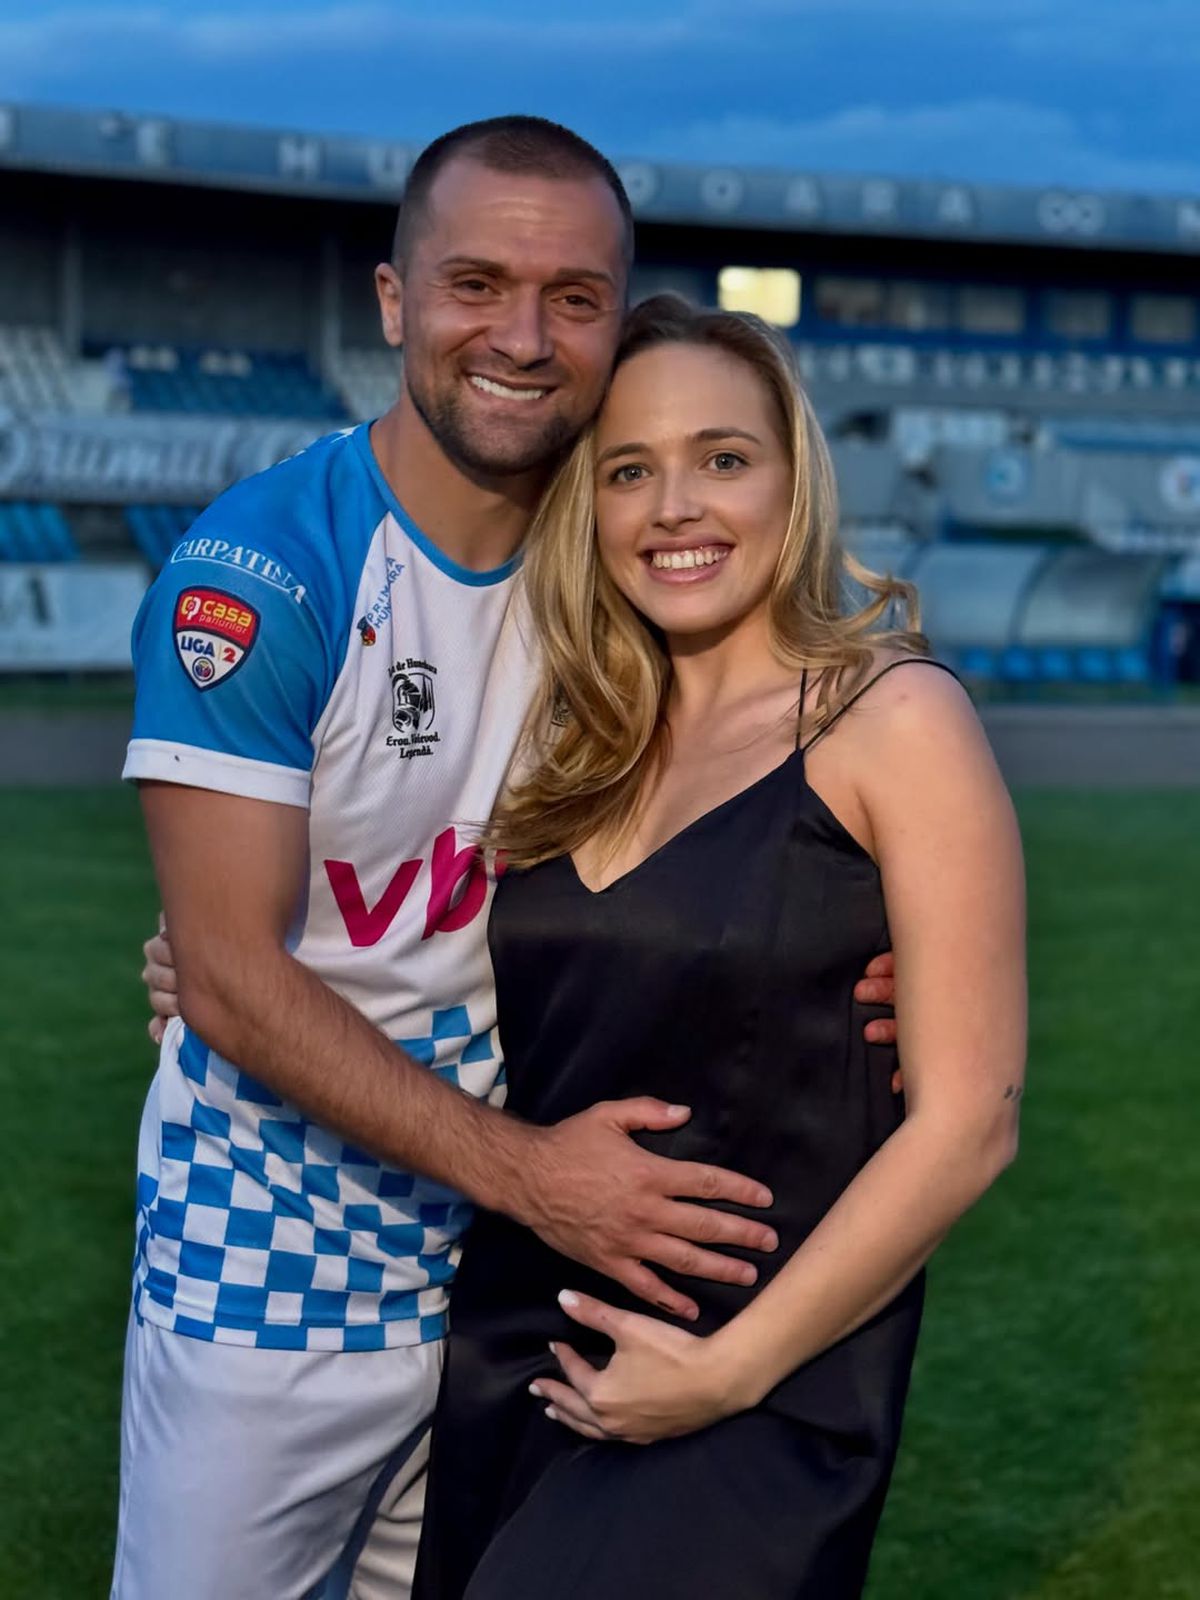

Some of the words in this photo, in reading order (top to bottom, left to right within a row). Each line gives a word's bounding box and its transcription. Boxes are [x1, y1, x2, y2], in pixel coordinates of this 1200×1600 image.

[170, 538, 307, 605] CARPATINA
[198, 613, 248, 635] pariurilor
[202, 600, 252, 628] casa
[180, 635, 216, 658] LIGA
[222, 647, 237, 664] 2
[323, 826, 508, 947] vb
